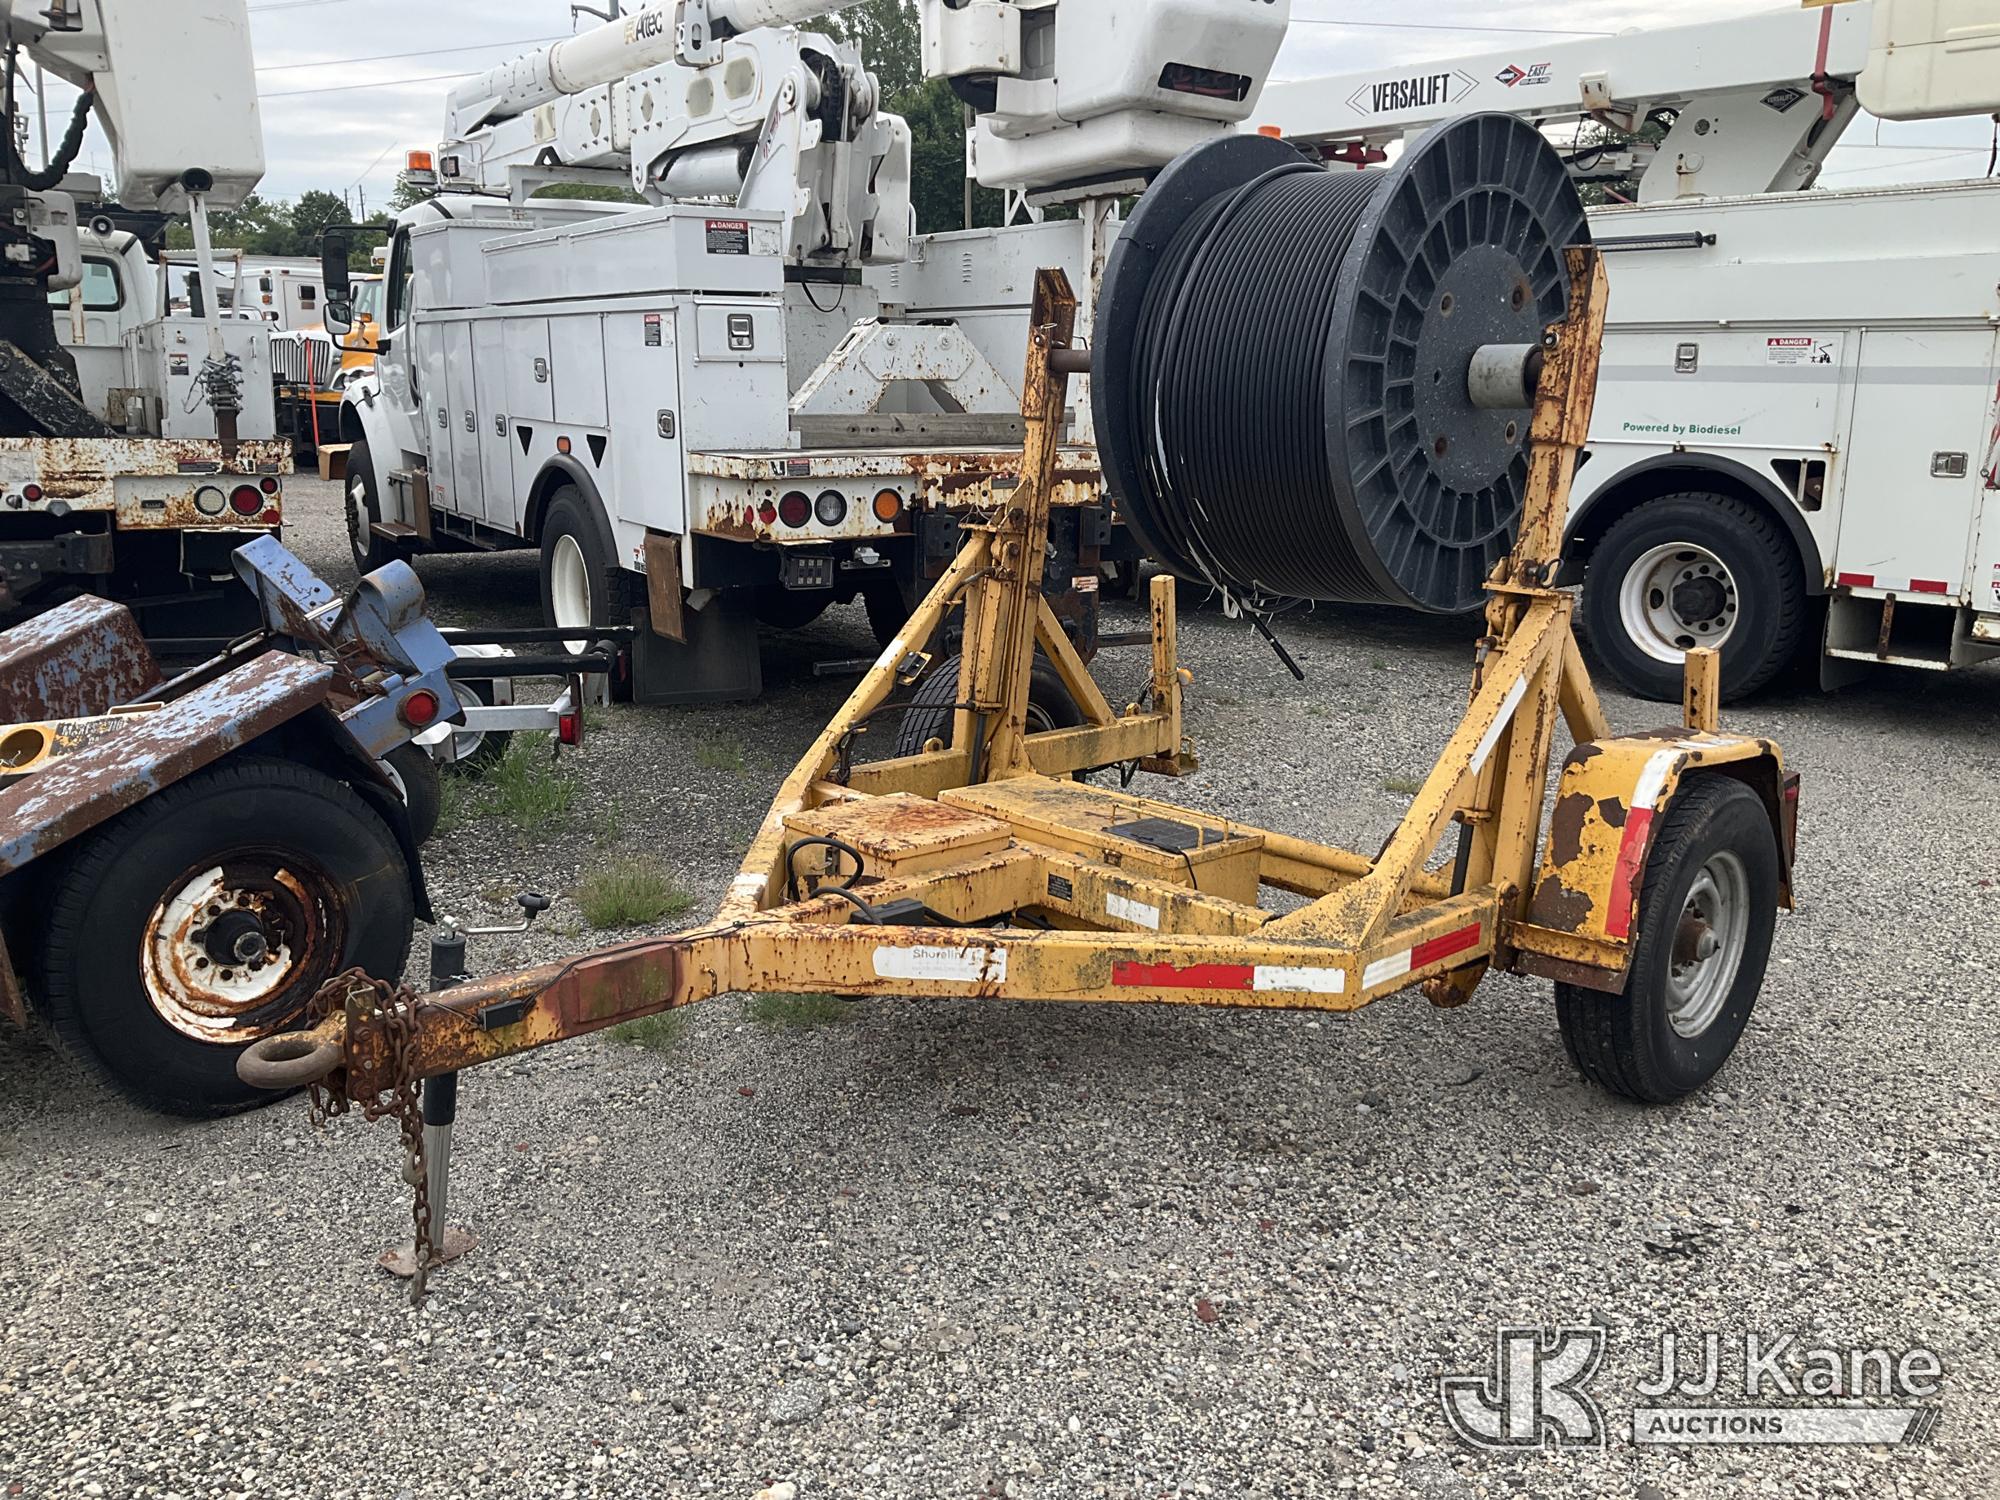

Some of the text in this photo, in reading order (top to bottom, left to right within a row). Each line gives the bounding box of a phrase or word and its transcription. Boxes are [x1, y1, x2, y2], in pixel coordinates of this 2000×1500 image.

[636, 11, 663, 40] Altec
[1527, 64, 1548, 77] EAST
[1373, 74, 1450, 112] VERSALIFT
[717, 221, 744, 230] DANGER
[1623, 422, 1741, 435] Powered by Biodiesel
